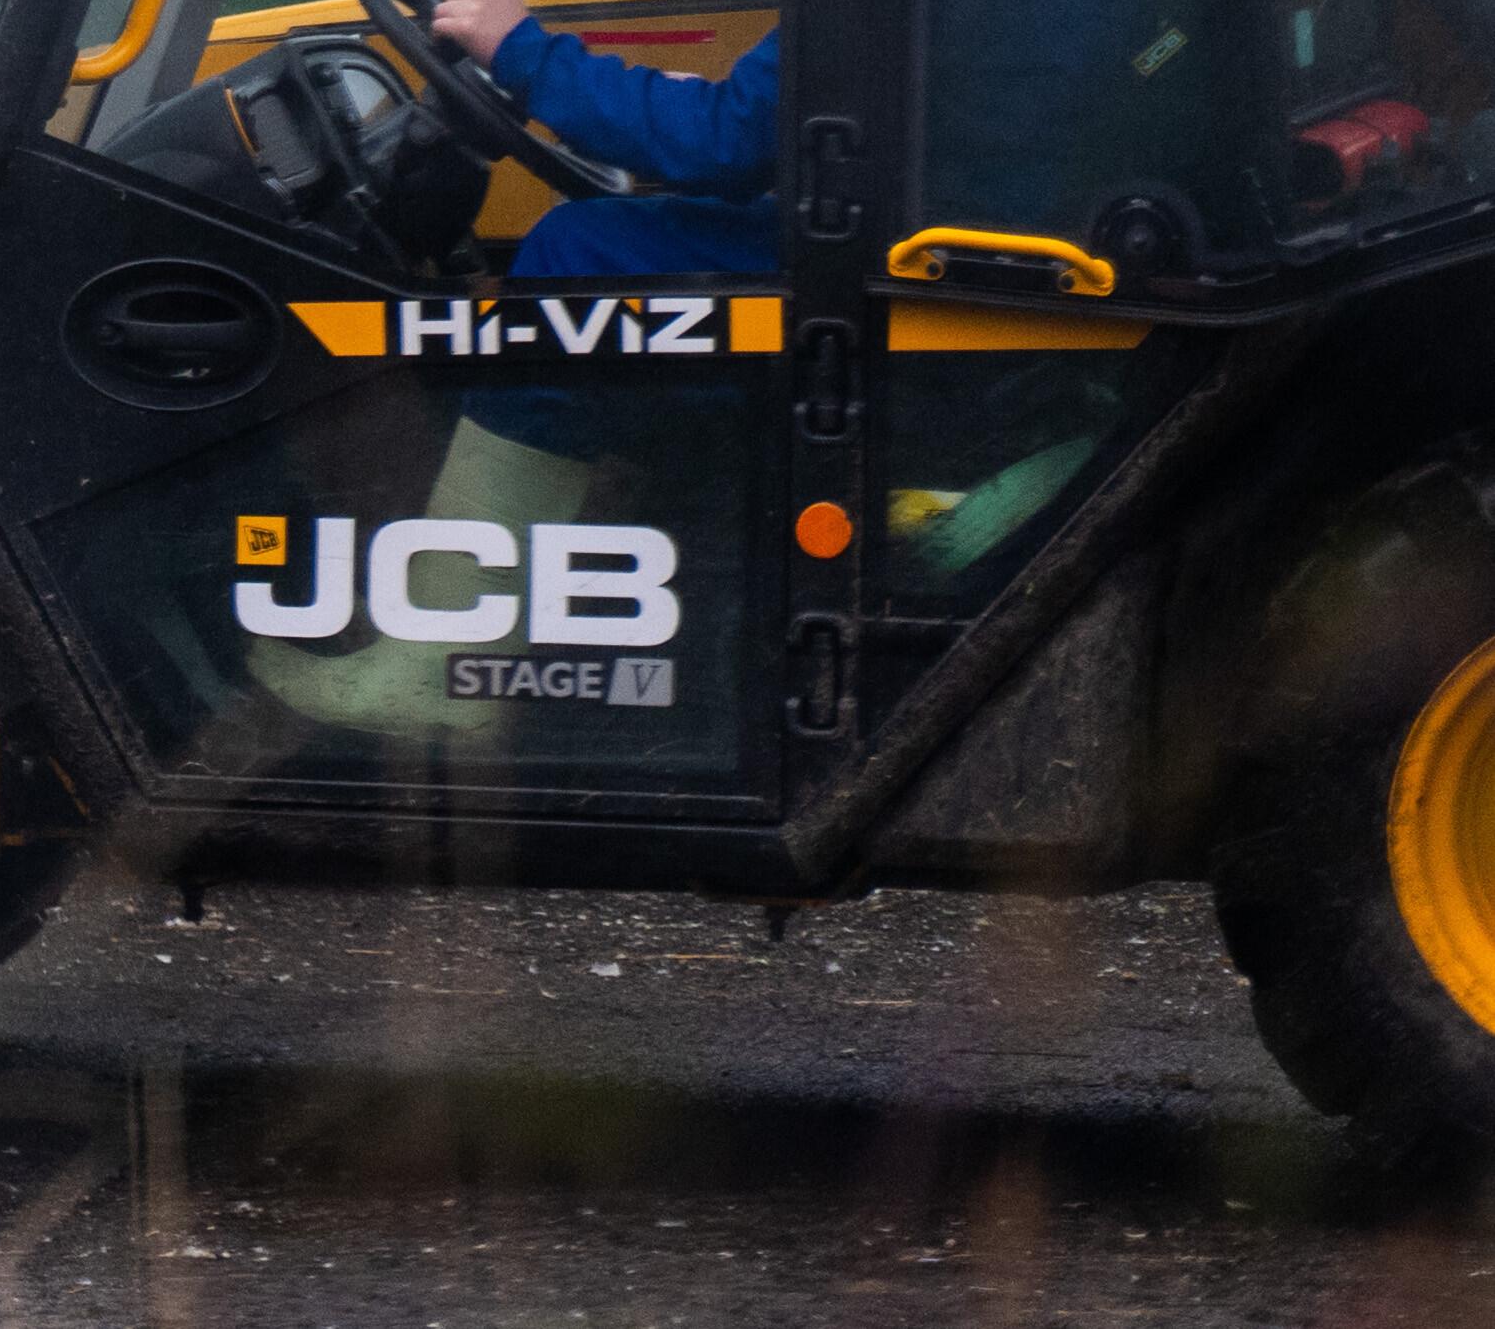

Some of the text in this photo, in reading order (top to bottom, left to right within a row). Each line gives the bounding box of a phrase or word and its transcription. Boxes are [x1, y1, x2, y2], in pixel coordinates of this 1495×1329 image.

[250, 529, 279, 552] JCB
[234, 517, 680, 646] JCB
[453, 659, 662, 700] STAGE V
